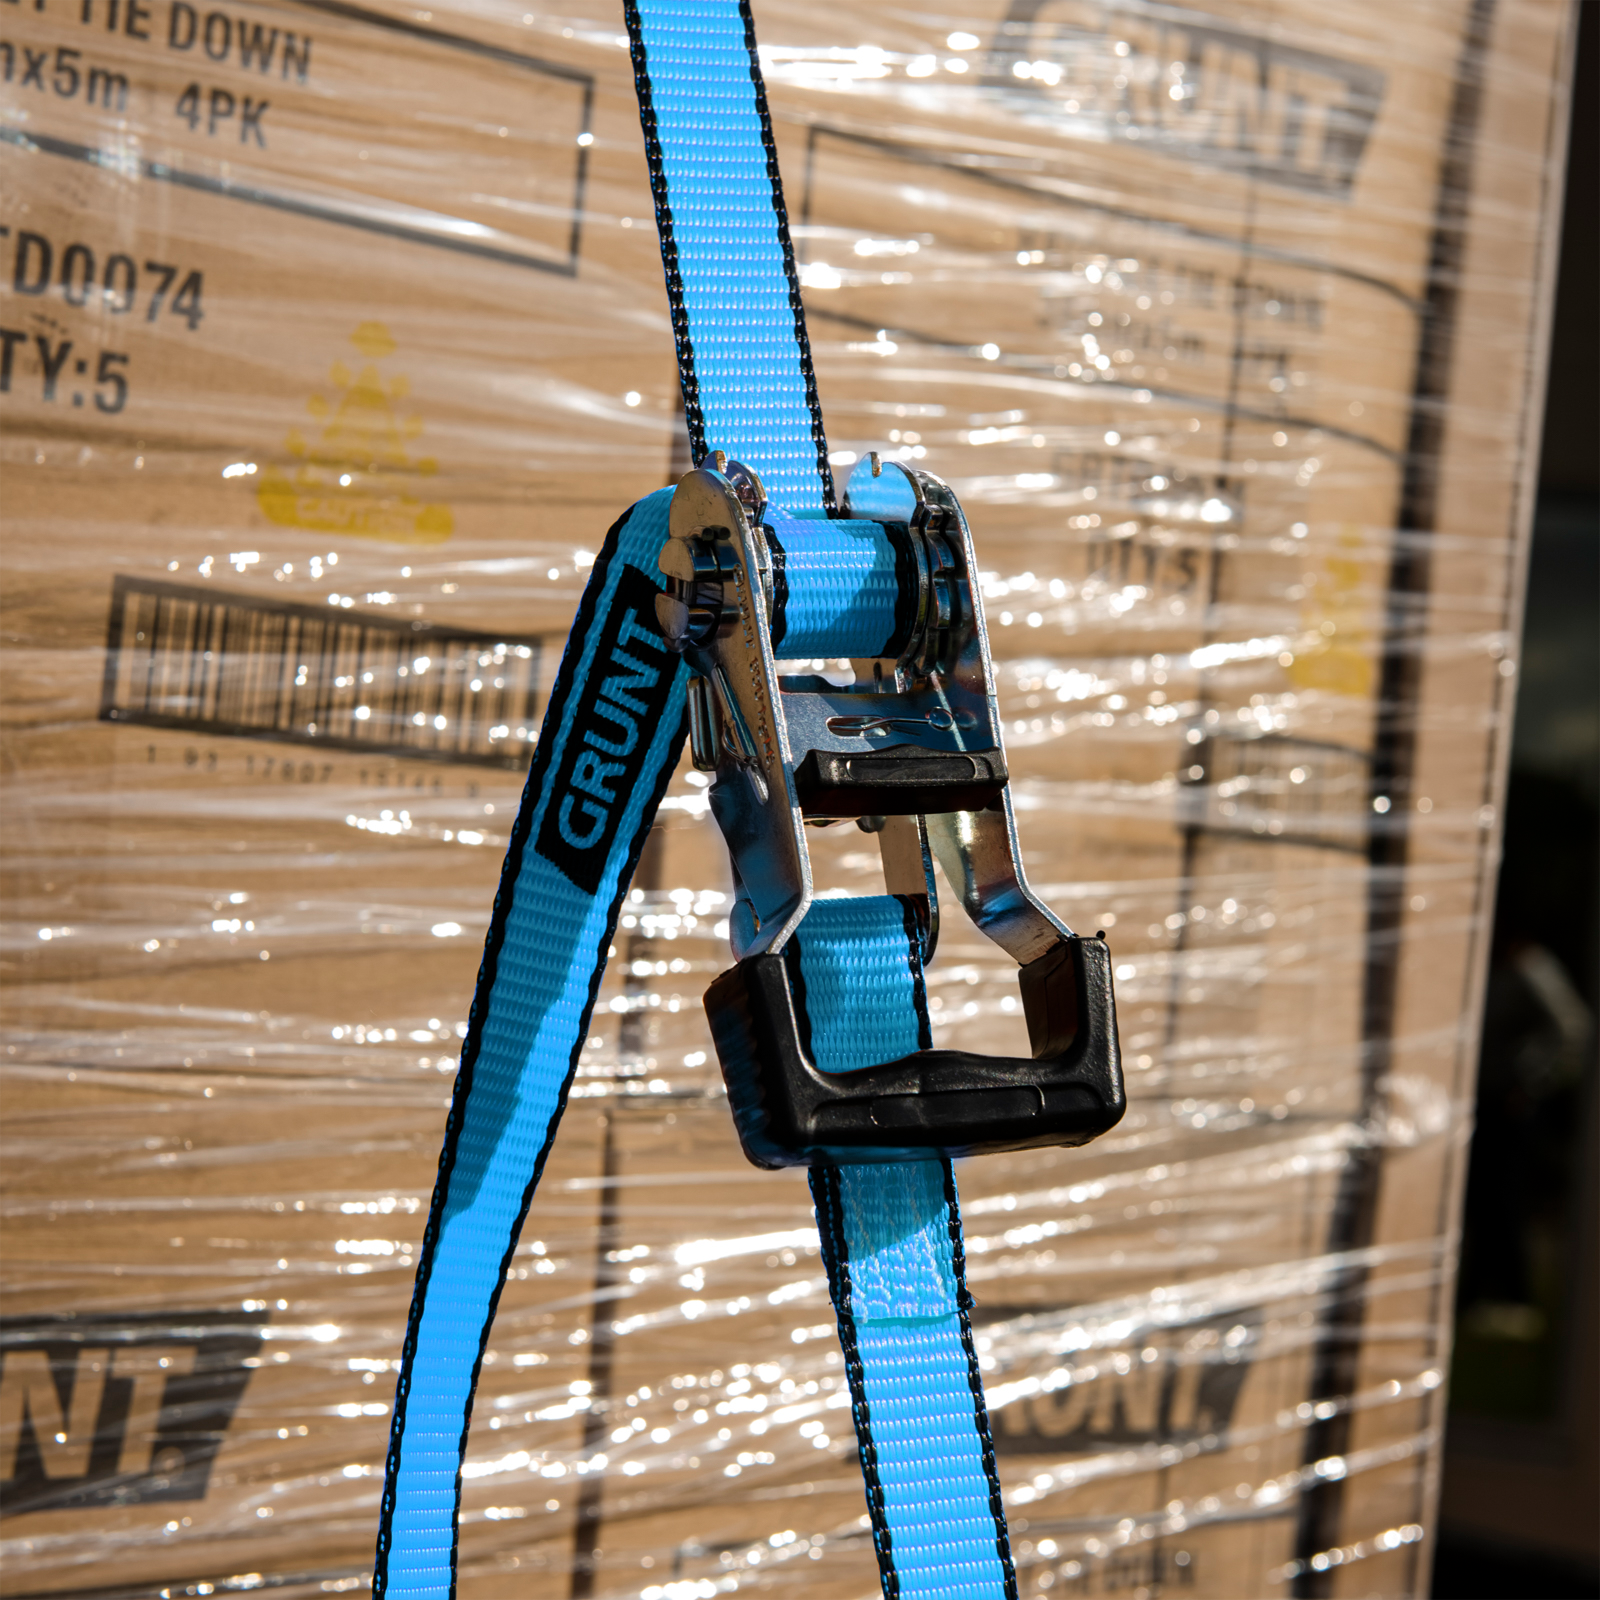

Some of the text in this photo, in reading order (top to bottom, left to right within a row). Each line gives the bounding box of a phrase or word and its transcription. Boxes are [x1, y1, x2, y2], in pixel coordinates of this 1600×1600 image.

[167, 1, 312, 85] DOWN
[175, 81, 269, 149] 4PK
[0, 327, 129, 415] TY:5
[558, 606, 667, 850] GRUNT
